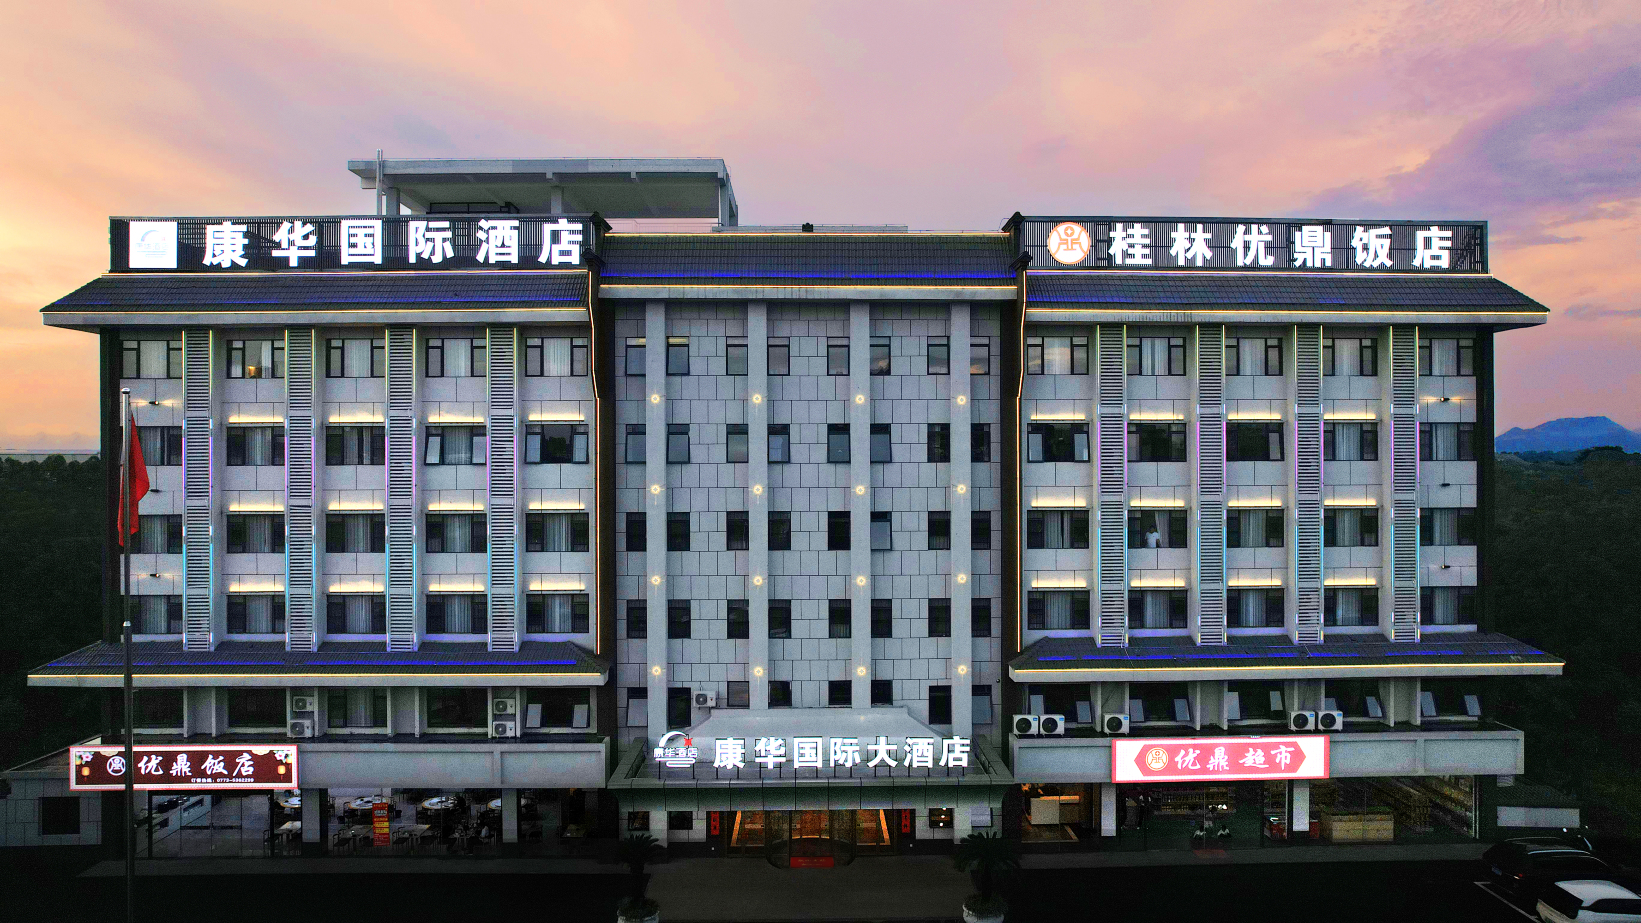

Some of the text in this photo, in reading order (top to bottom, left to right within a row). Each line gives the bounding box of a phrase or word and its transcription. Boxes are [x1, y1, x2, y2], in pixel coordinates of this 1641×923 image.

[203, 219, 583, 267] 康华国际酒店
[1108, 223, 1453, 269] 桂林优鼎饭店
[137, 752, 255, 777] 优鼎饭店
[713, 736, 971, 769] 康华国际大酒店
[1174, 744, 1296, 771] 优鼎超市
